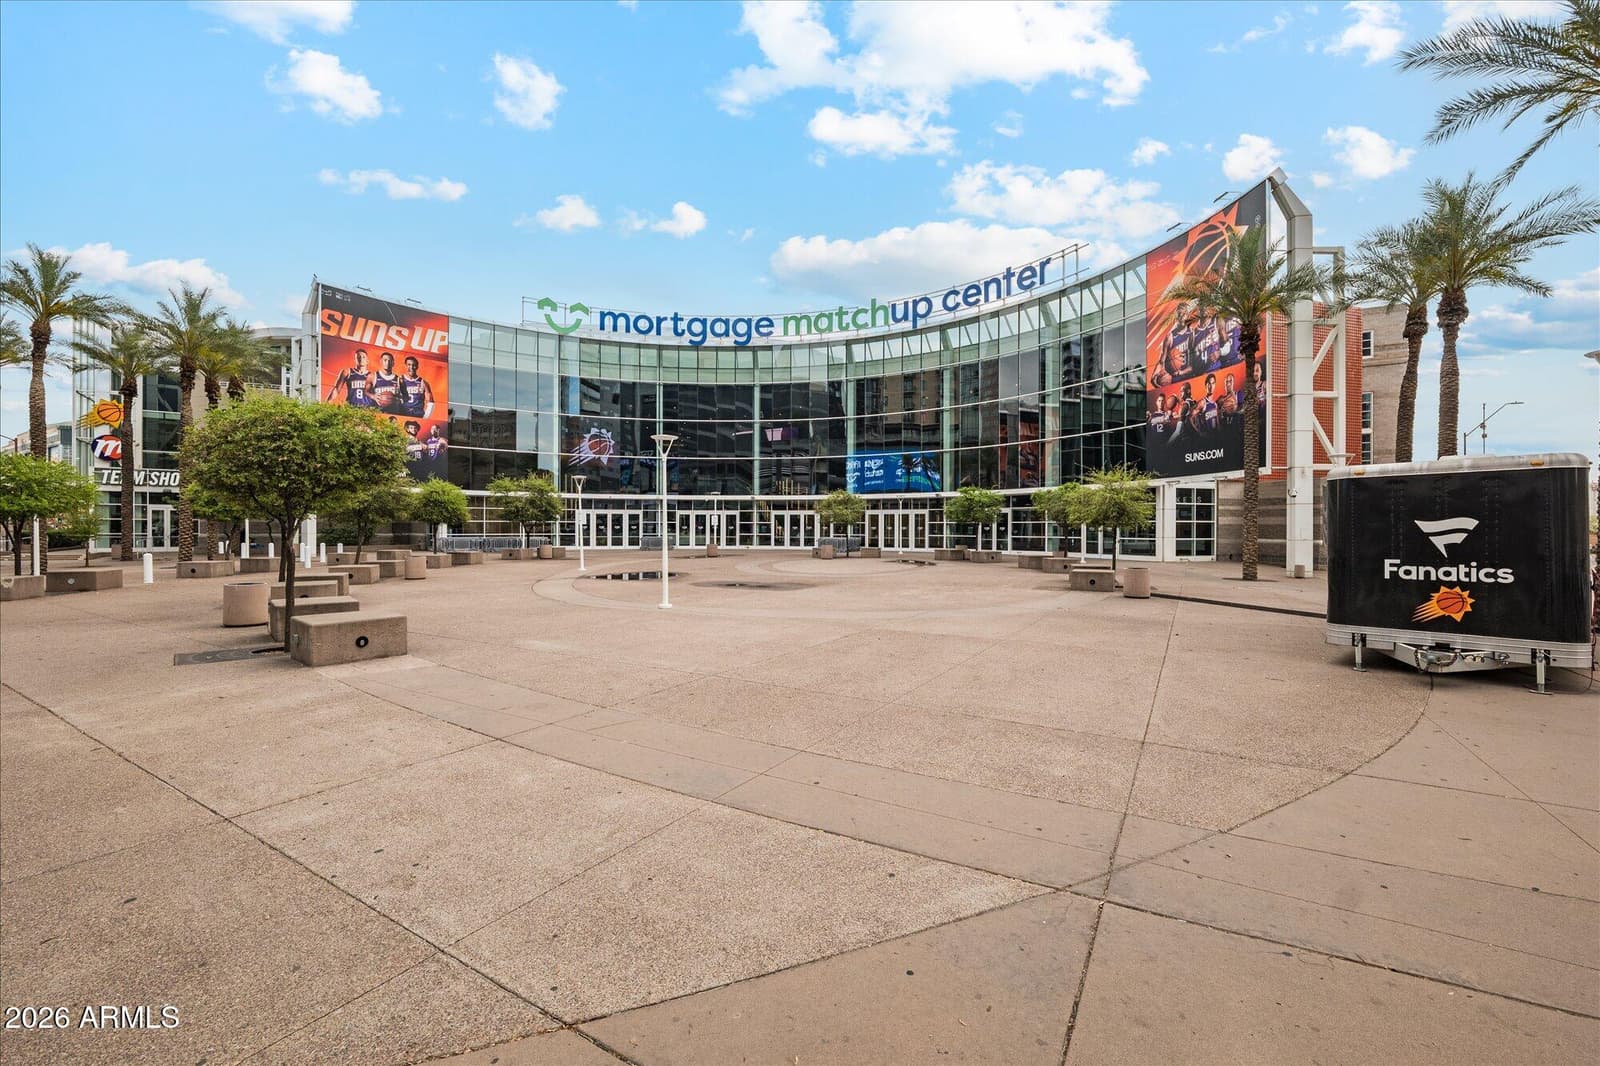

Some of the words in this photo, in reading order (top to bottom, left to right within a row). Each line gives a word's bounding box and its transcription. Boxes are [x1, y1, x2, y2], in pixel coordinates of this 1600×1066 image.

[600, 310, 775, 346] mortgage
[783, 296, 933, 335] matchup
[942, 257, 1052, 312] center
[410, 325, 449, 353] UP
[1185, 448, 1224, 462] SUNS.COM
[102, 470, 145, 486] TEM
[149, 471, 180, 487] SHO
[1384, 559, 1515, 583] Fanatics
